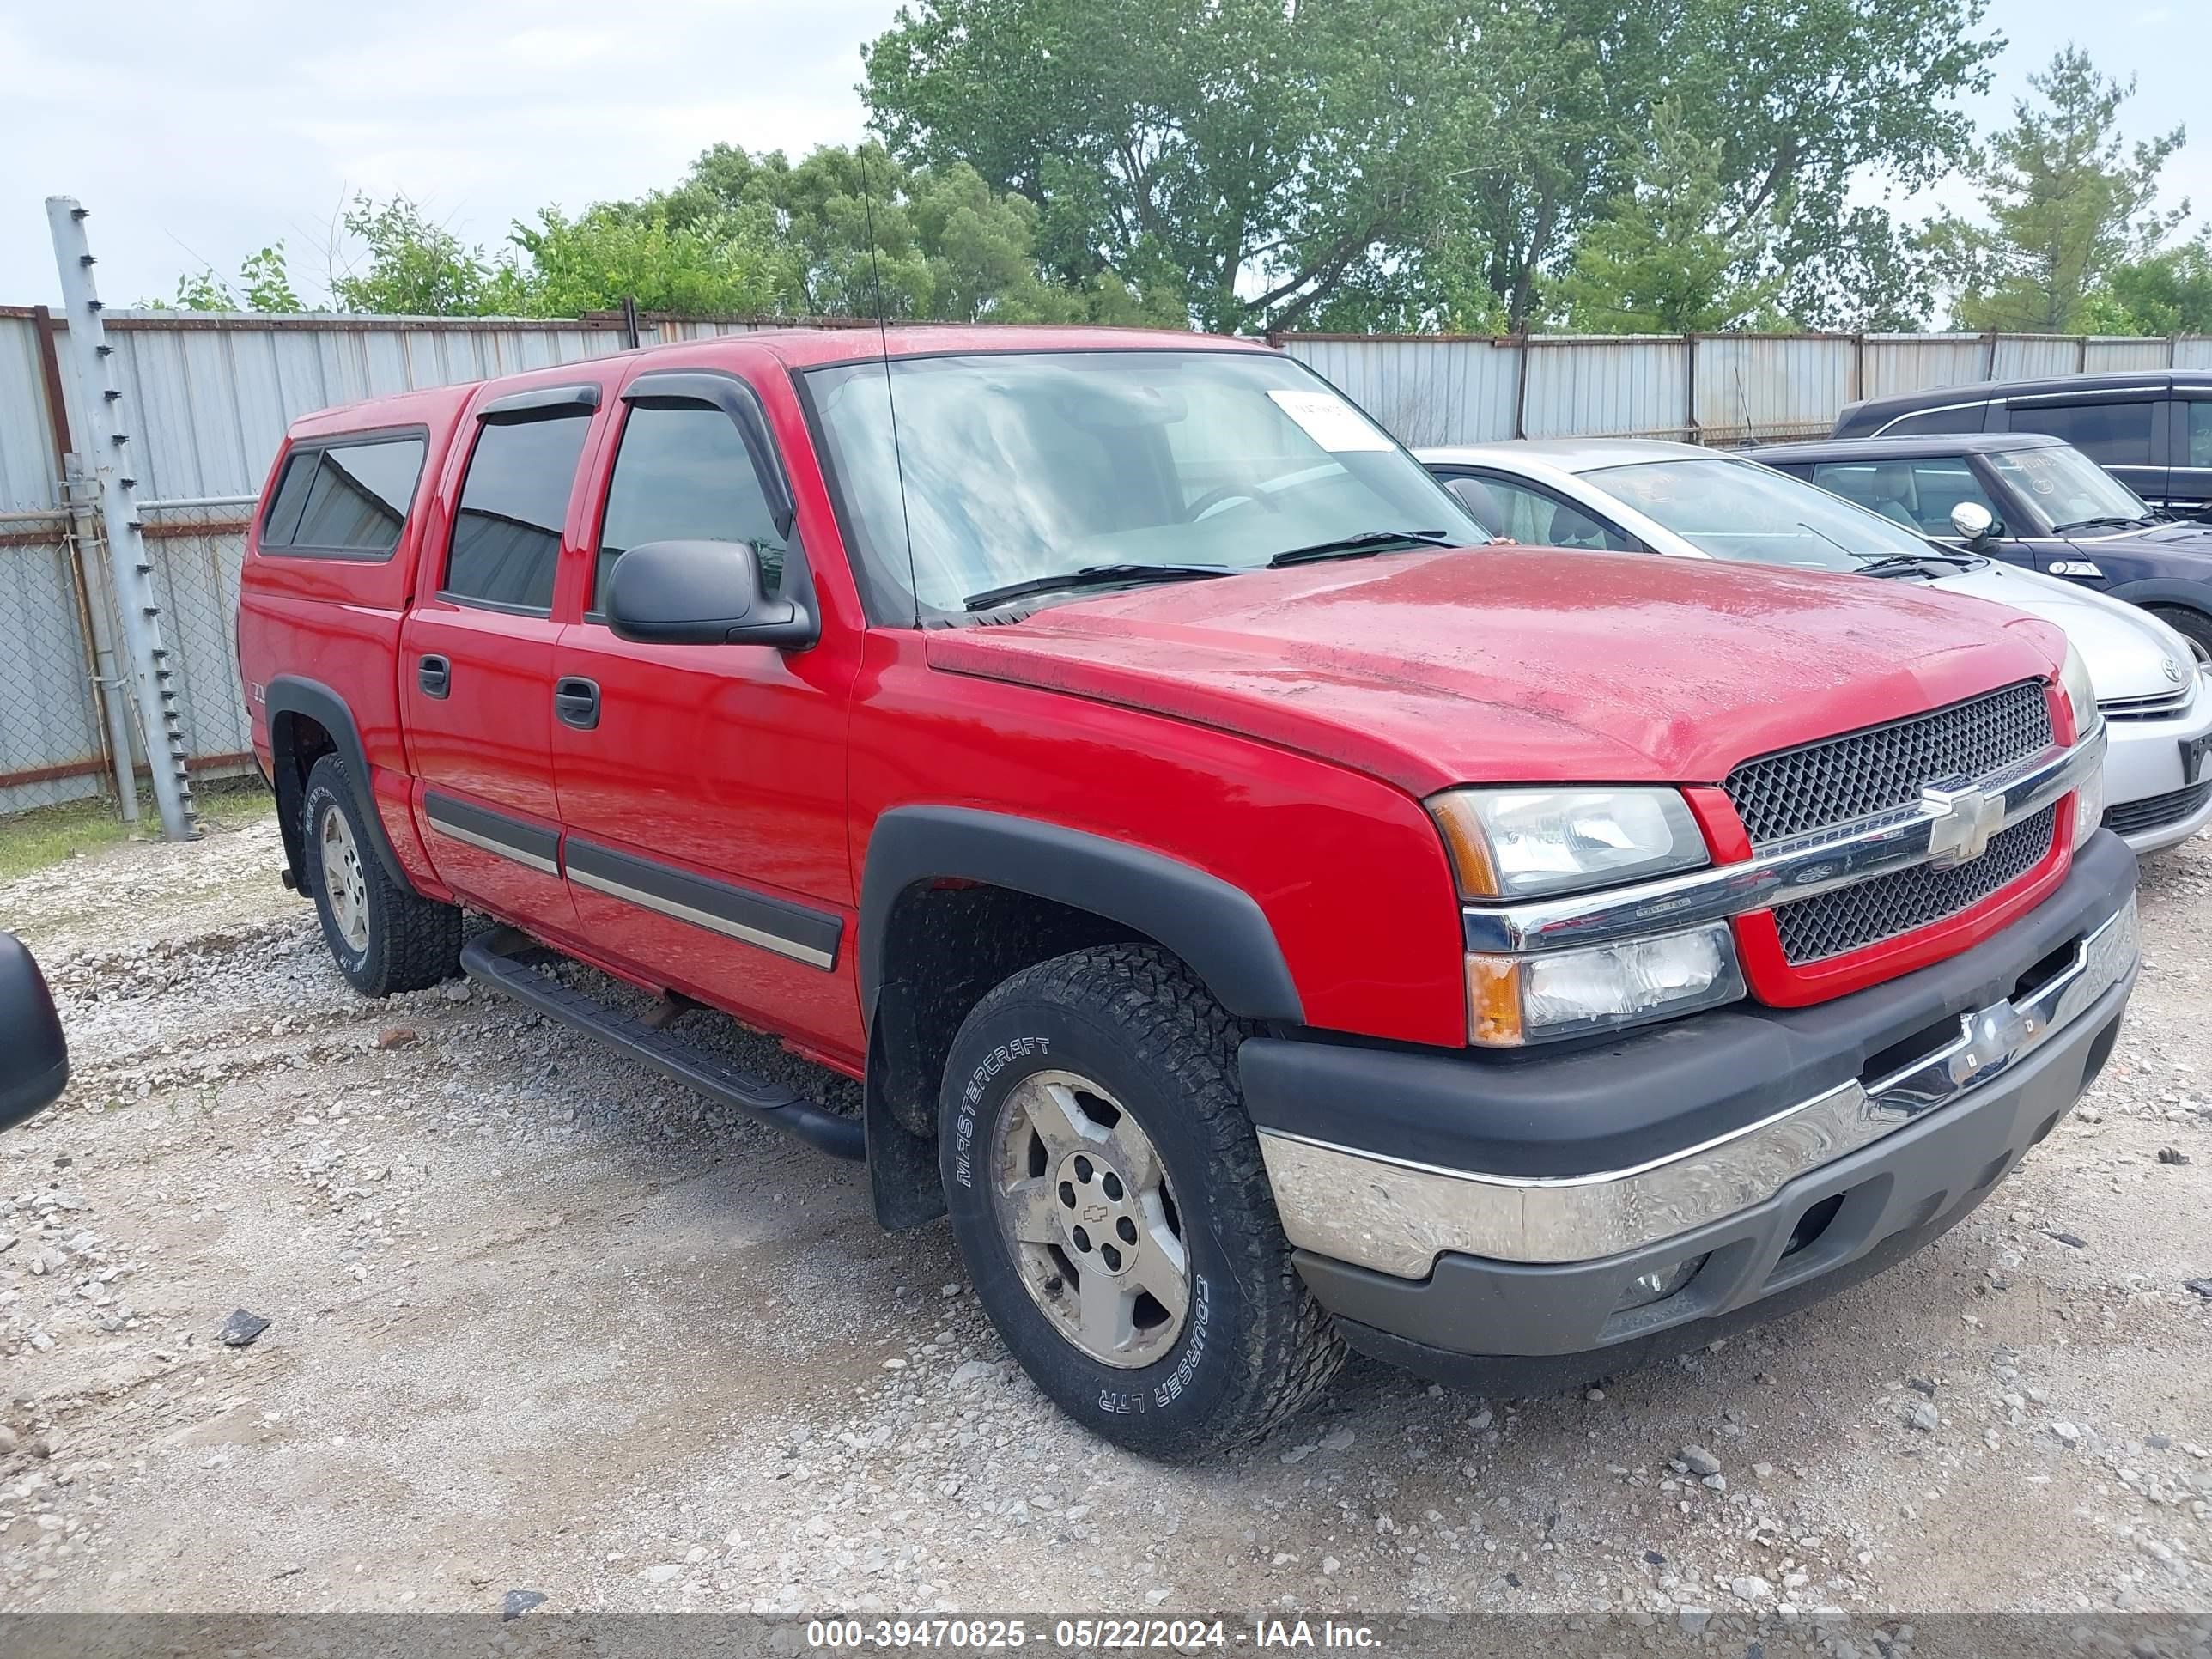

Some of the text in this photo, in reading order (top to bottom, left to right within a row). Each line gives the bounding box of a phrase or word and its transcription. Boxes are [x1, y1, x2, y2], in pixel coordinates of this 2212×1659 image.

[955, 1036, 1050, 1188] MASTERCRAFT
[1098, 1273, 1209, 1415] COURSER LTR
